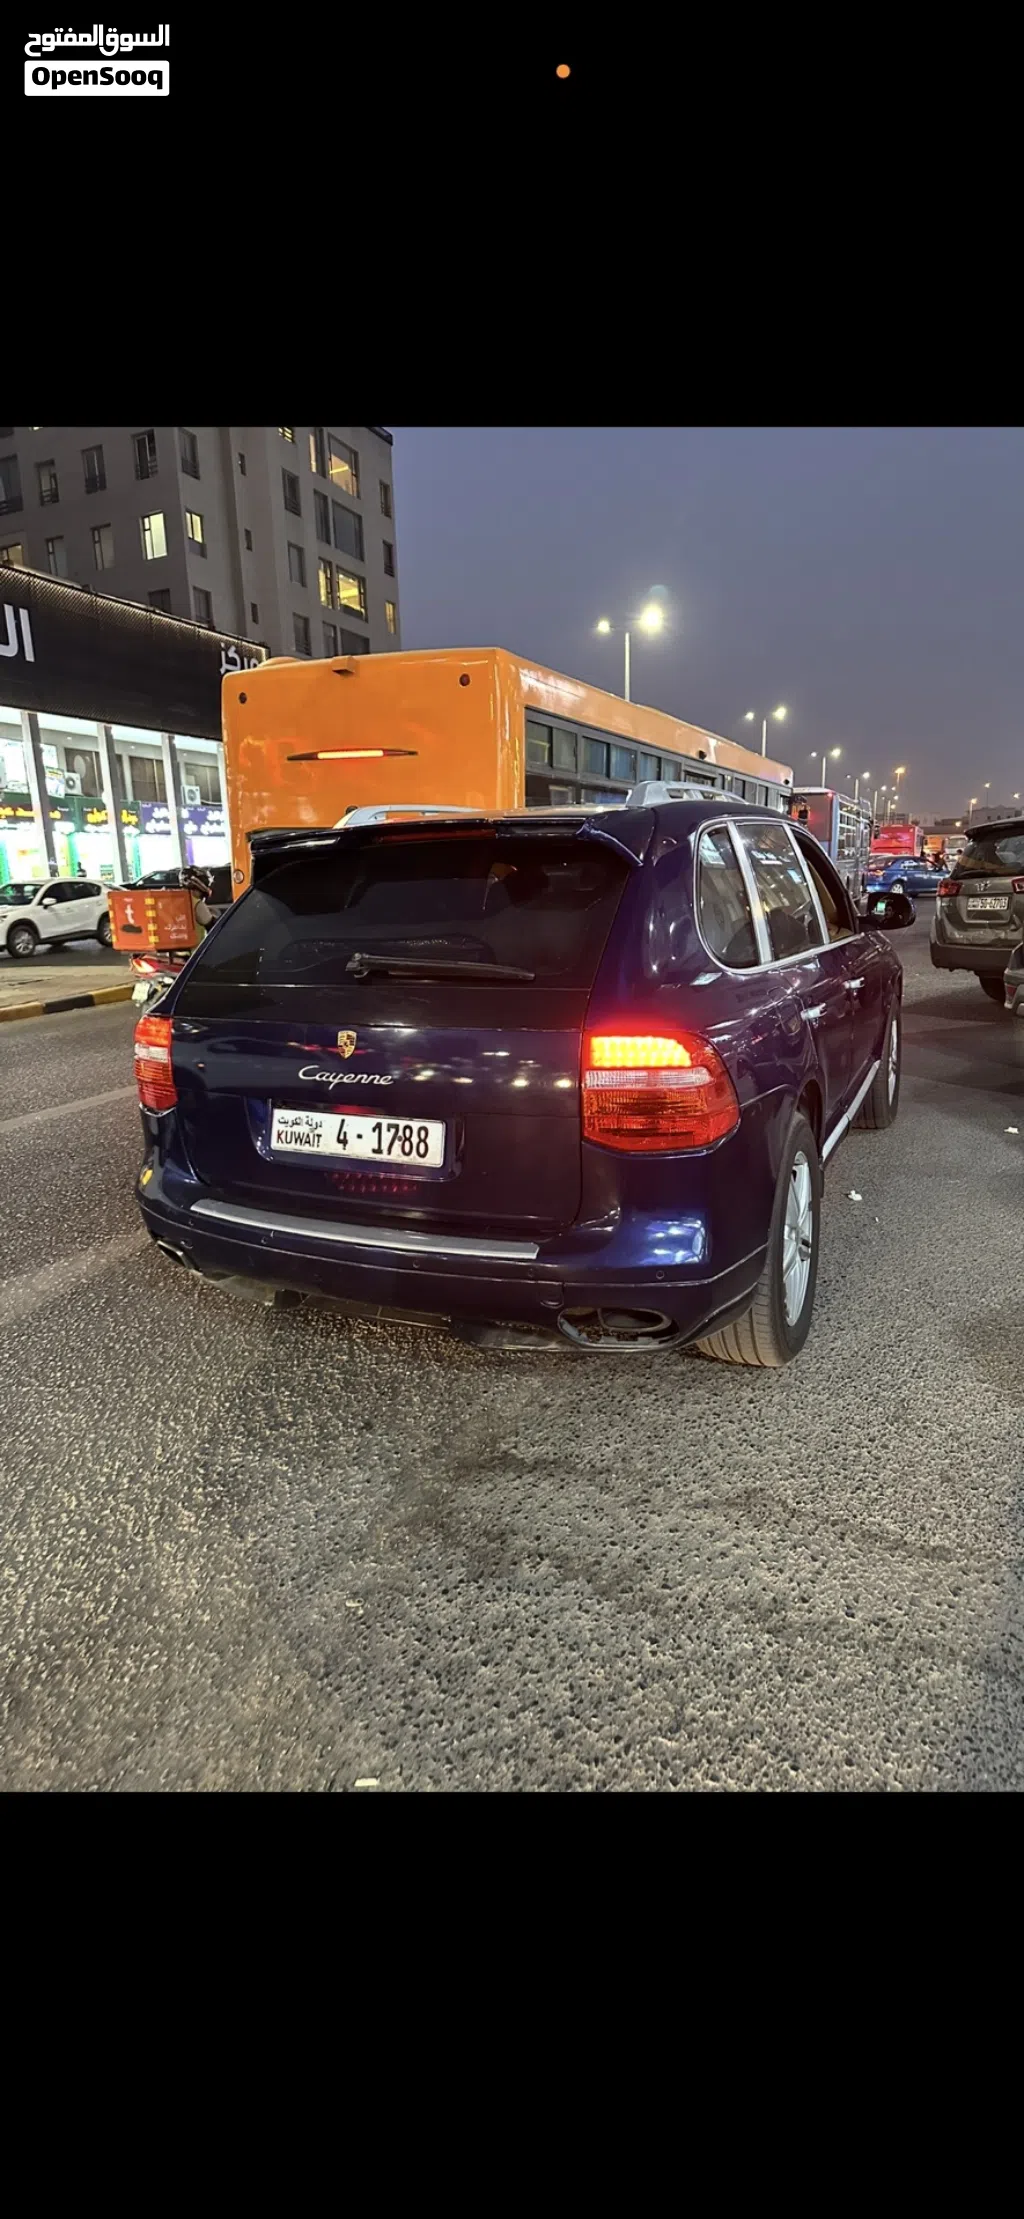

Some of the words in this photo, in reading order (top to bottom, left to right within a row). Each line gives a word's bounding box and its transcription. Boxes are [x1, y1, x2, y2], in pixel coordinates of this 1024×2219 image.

[298, 1065, 394, 1090] Cayenne
[277, 1116, 303, 1128] الكويت
[305, 1115, 323, 1130] دولة
[276, 1129, 322, 1148] KUWAIT
[336, 1118, 349, 1151] 4
[371, 1121, 429, 1159] 1788
